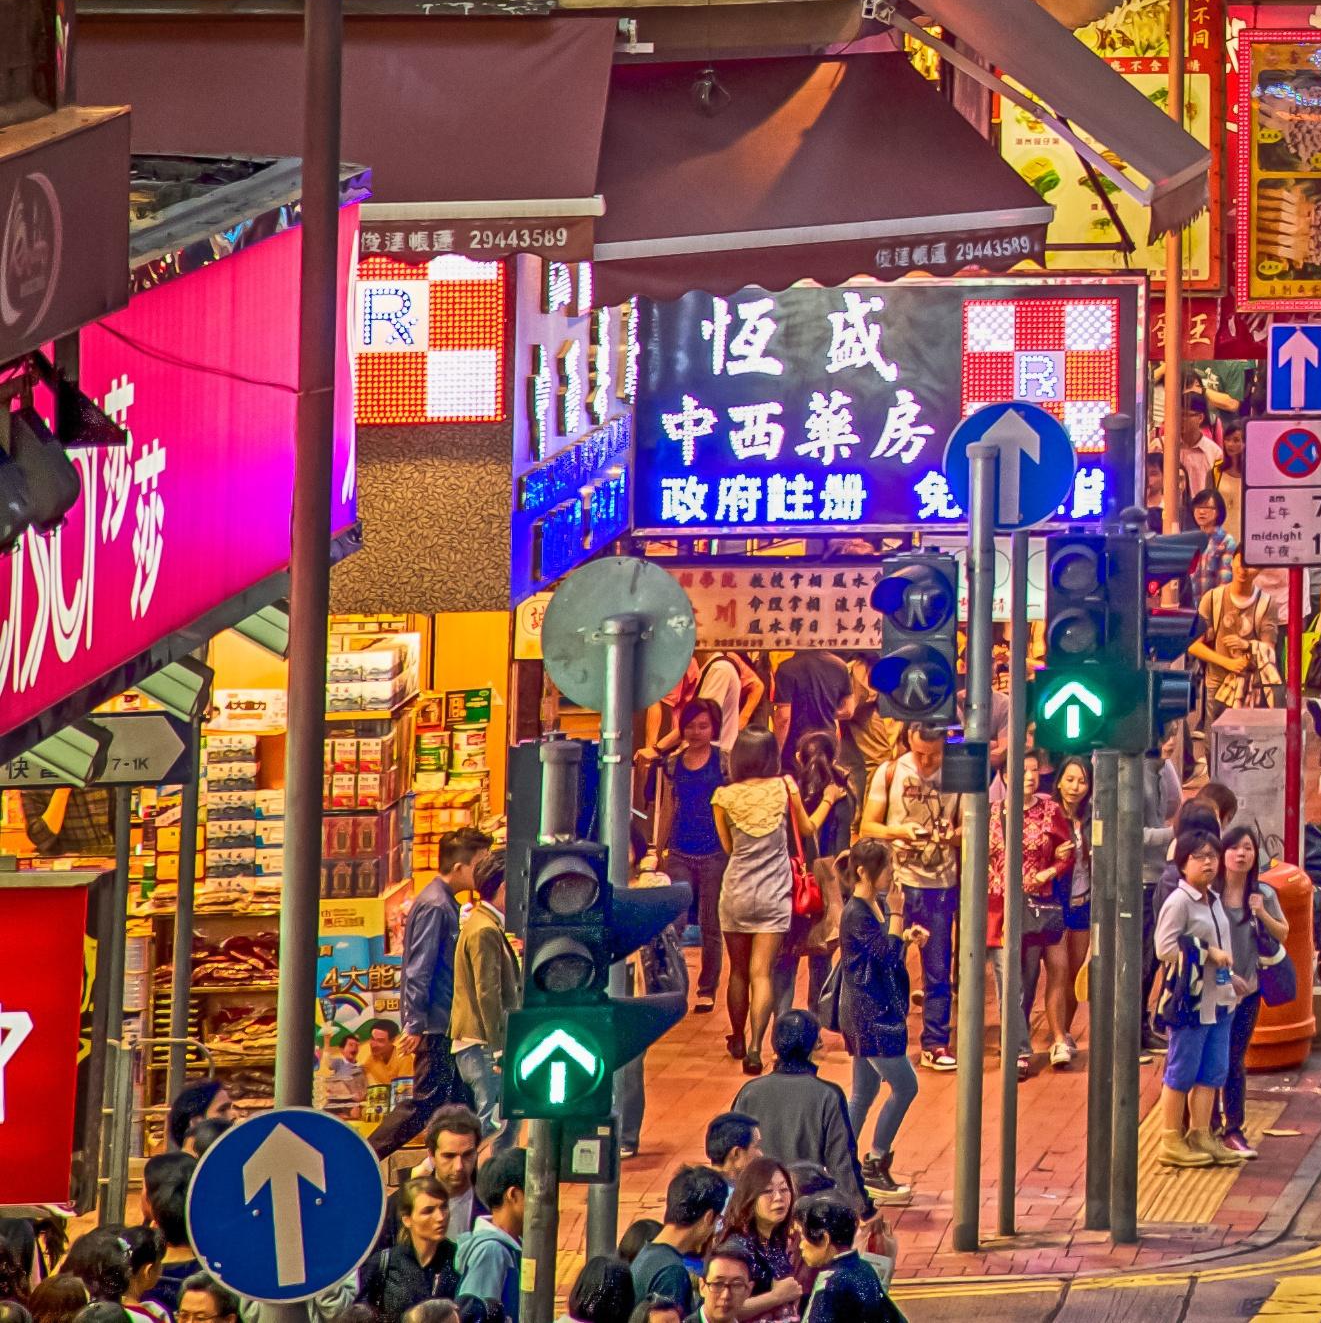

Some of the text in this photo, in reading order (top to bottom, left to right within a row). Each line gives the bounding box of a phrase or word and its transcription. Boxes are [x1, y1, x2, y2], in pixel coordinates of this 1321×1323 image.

[469, 228, 567, 249] 29443589
[955, 236, 1030, 261] 29443589
[661, 389, 935, 467] 中西藥房
[1264, 506, 1290, 520] 上午
[1251, 530, 1302, 544] midnight
